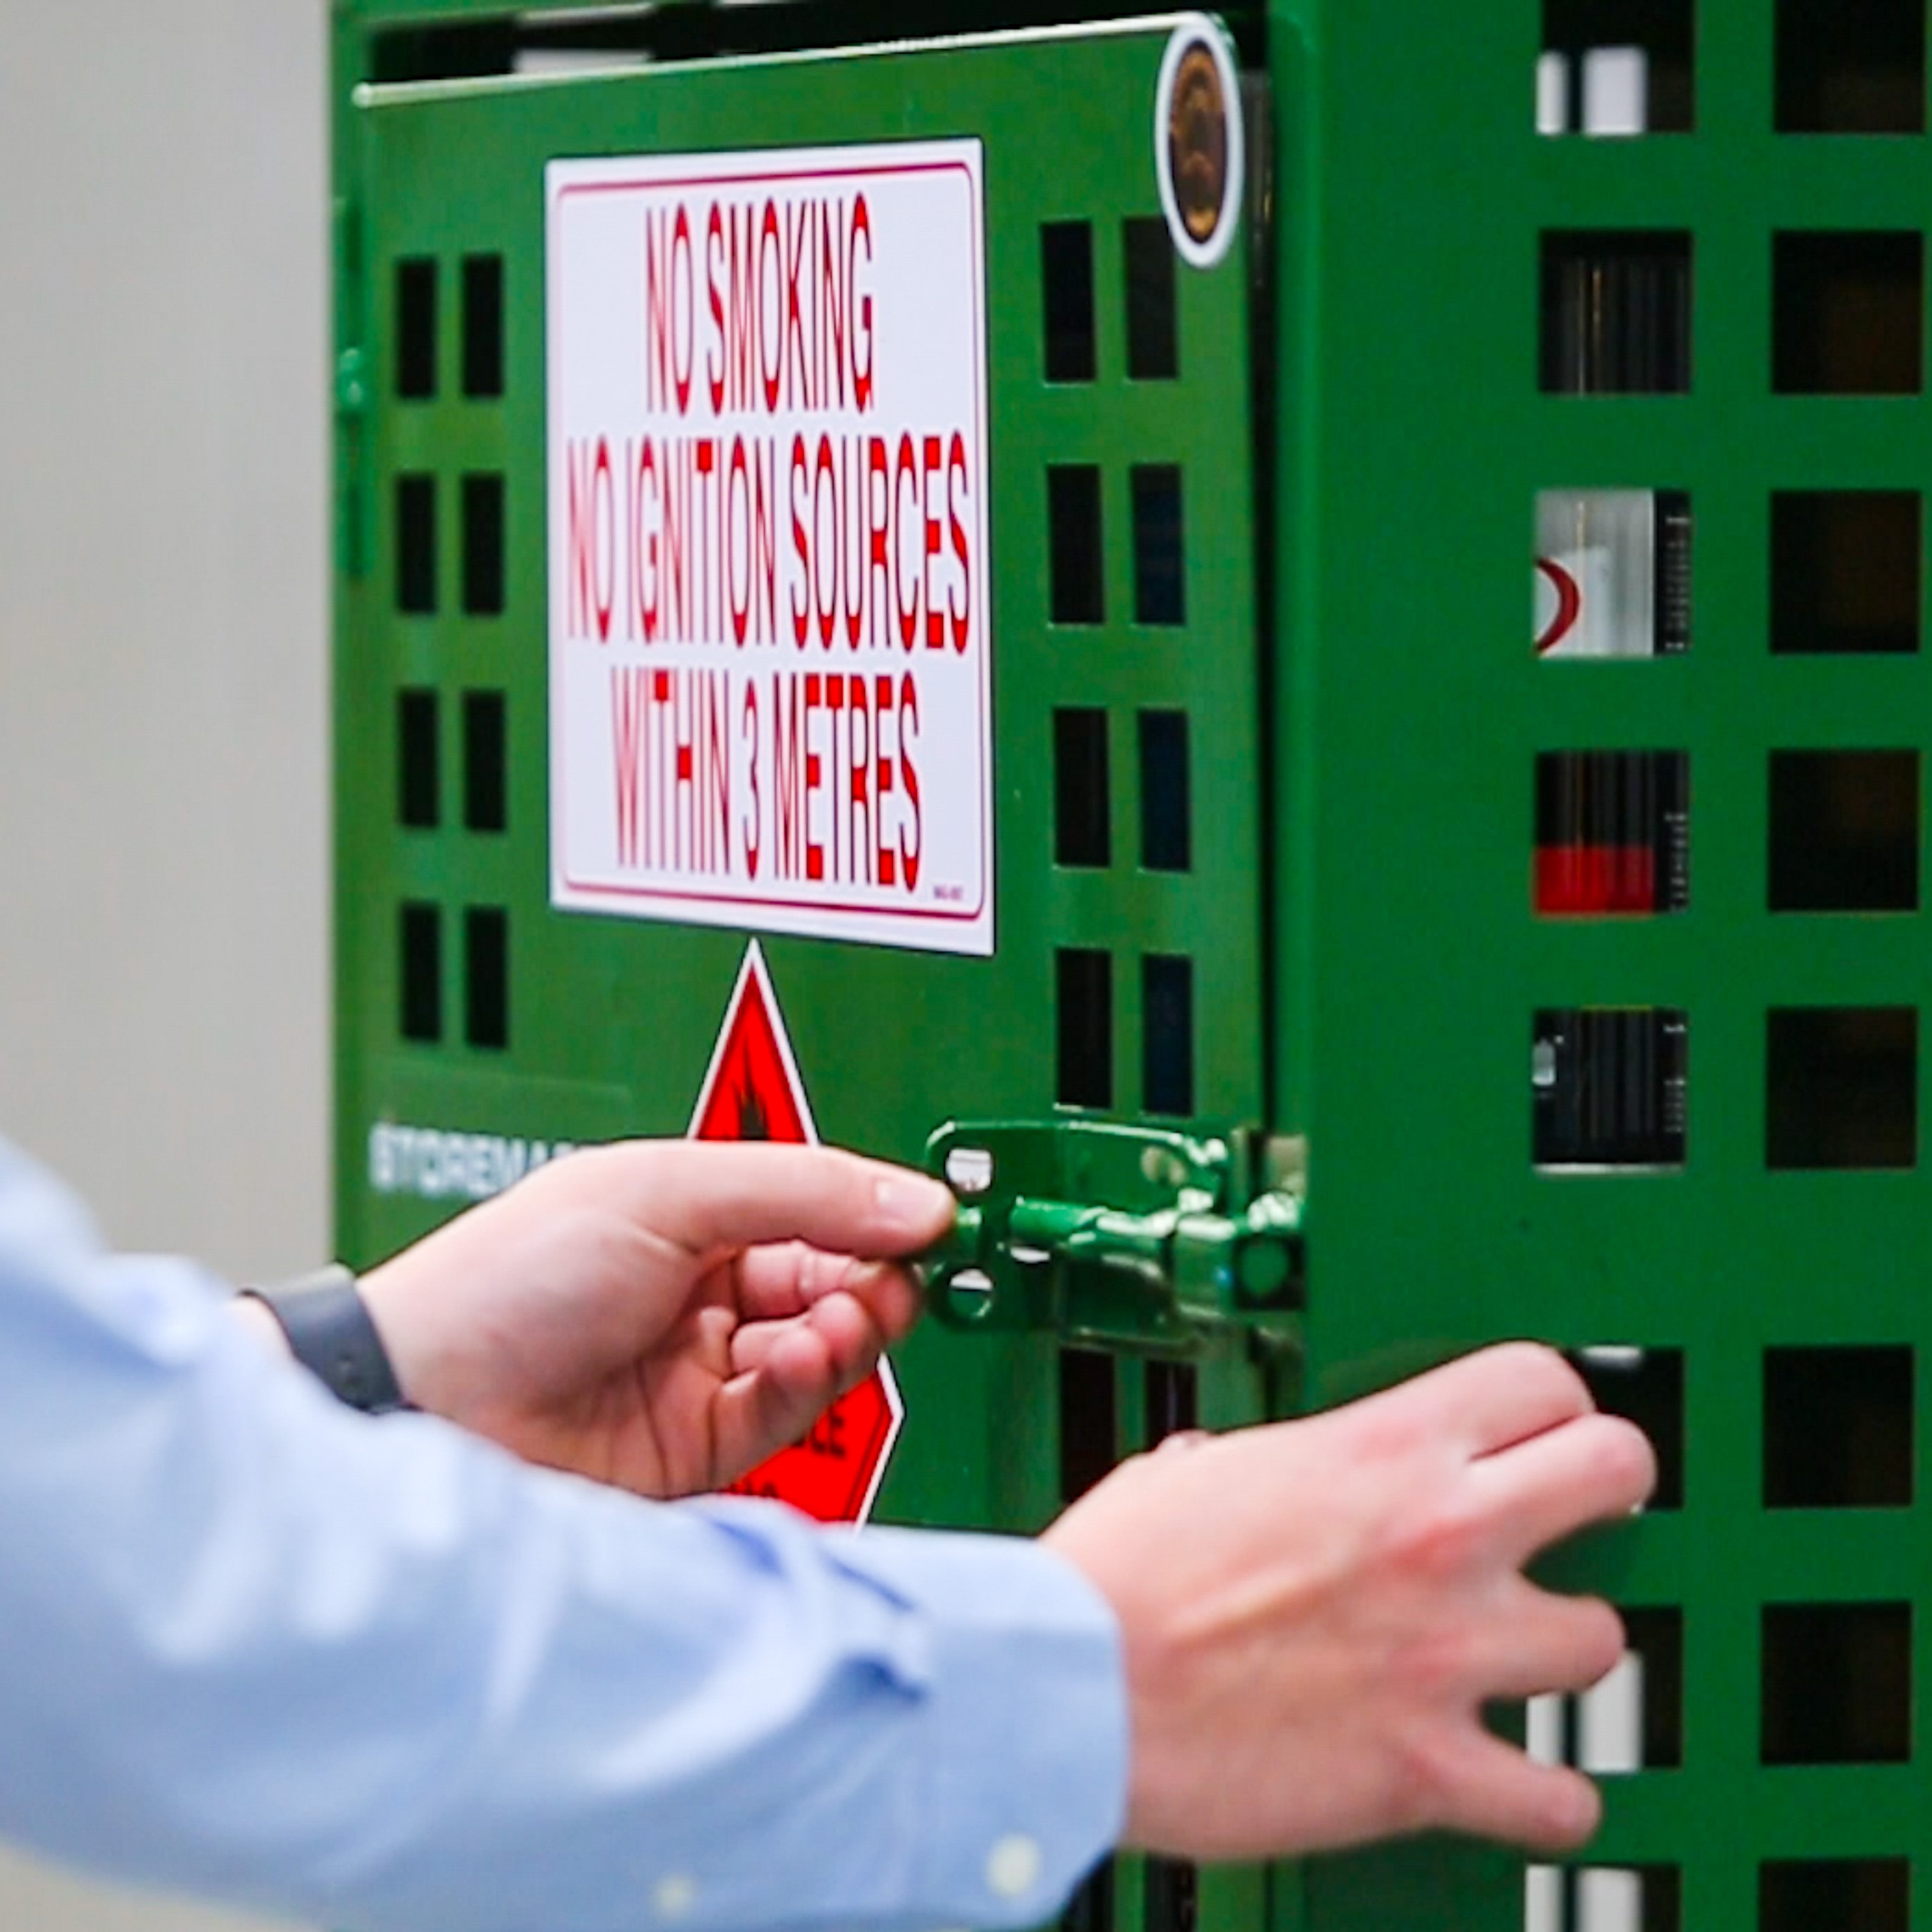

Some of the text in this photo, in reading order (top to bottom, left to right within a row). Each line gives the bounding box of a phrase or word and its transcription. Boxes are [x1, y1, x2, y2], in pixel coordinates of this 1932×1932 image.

[646, 191, 874, 417] NO SMOKING
[568, 428, 969, 656] NO IGNITION SOURCES
[610, 664, 921, 893] WITHIN 3 METRES
